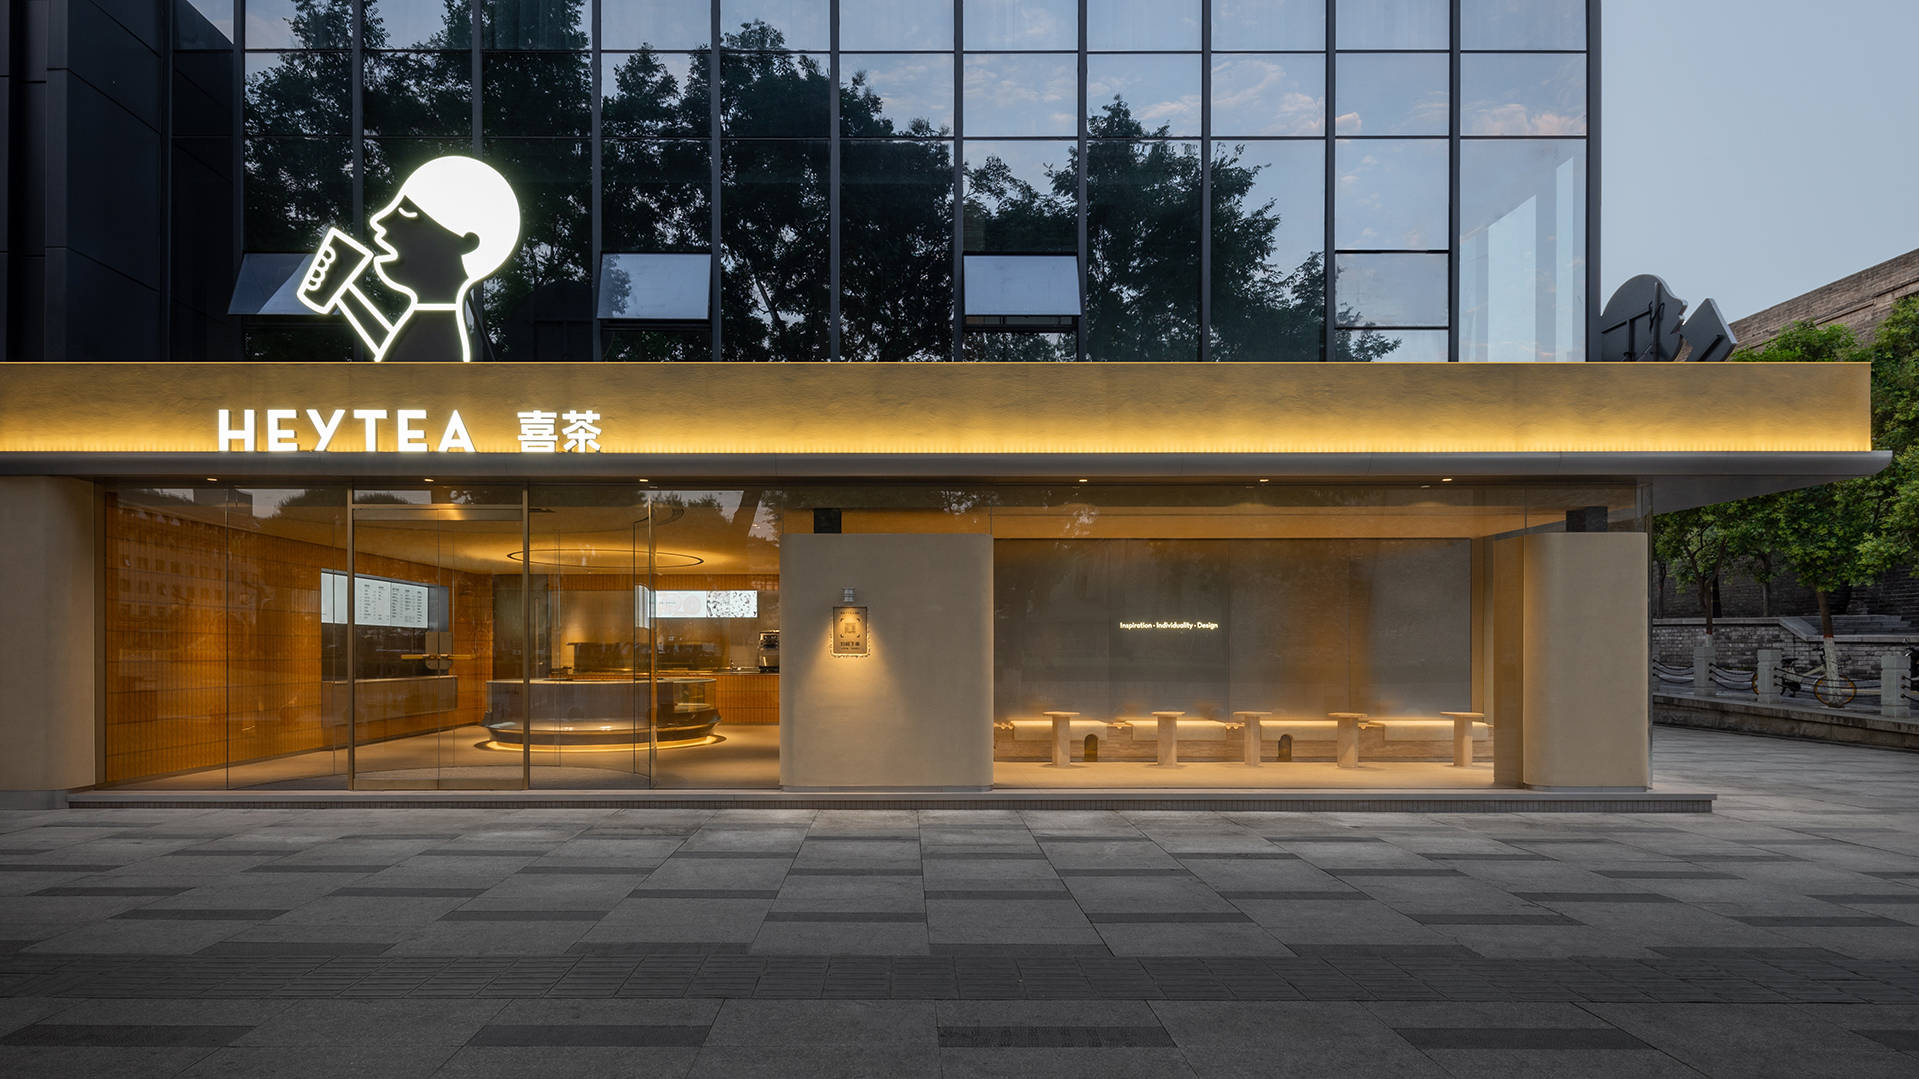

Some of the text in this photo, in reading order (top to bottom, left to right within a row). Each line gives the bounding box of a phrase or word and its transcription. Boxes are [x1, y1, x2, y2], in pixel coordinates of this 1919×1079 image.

[218, 409, 601, 453] HEYTEA 喜茶
[1120, 621, 1218, 630] Inspiration Individuality Design
